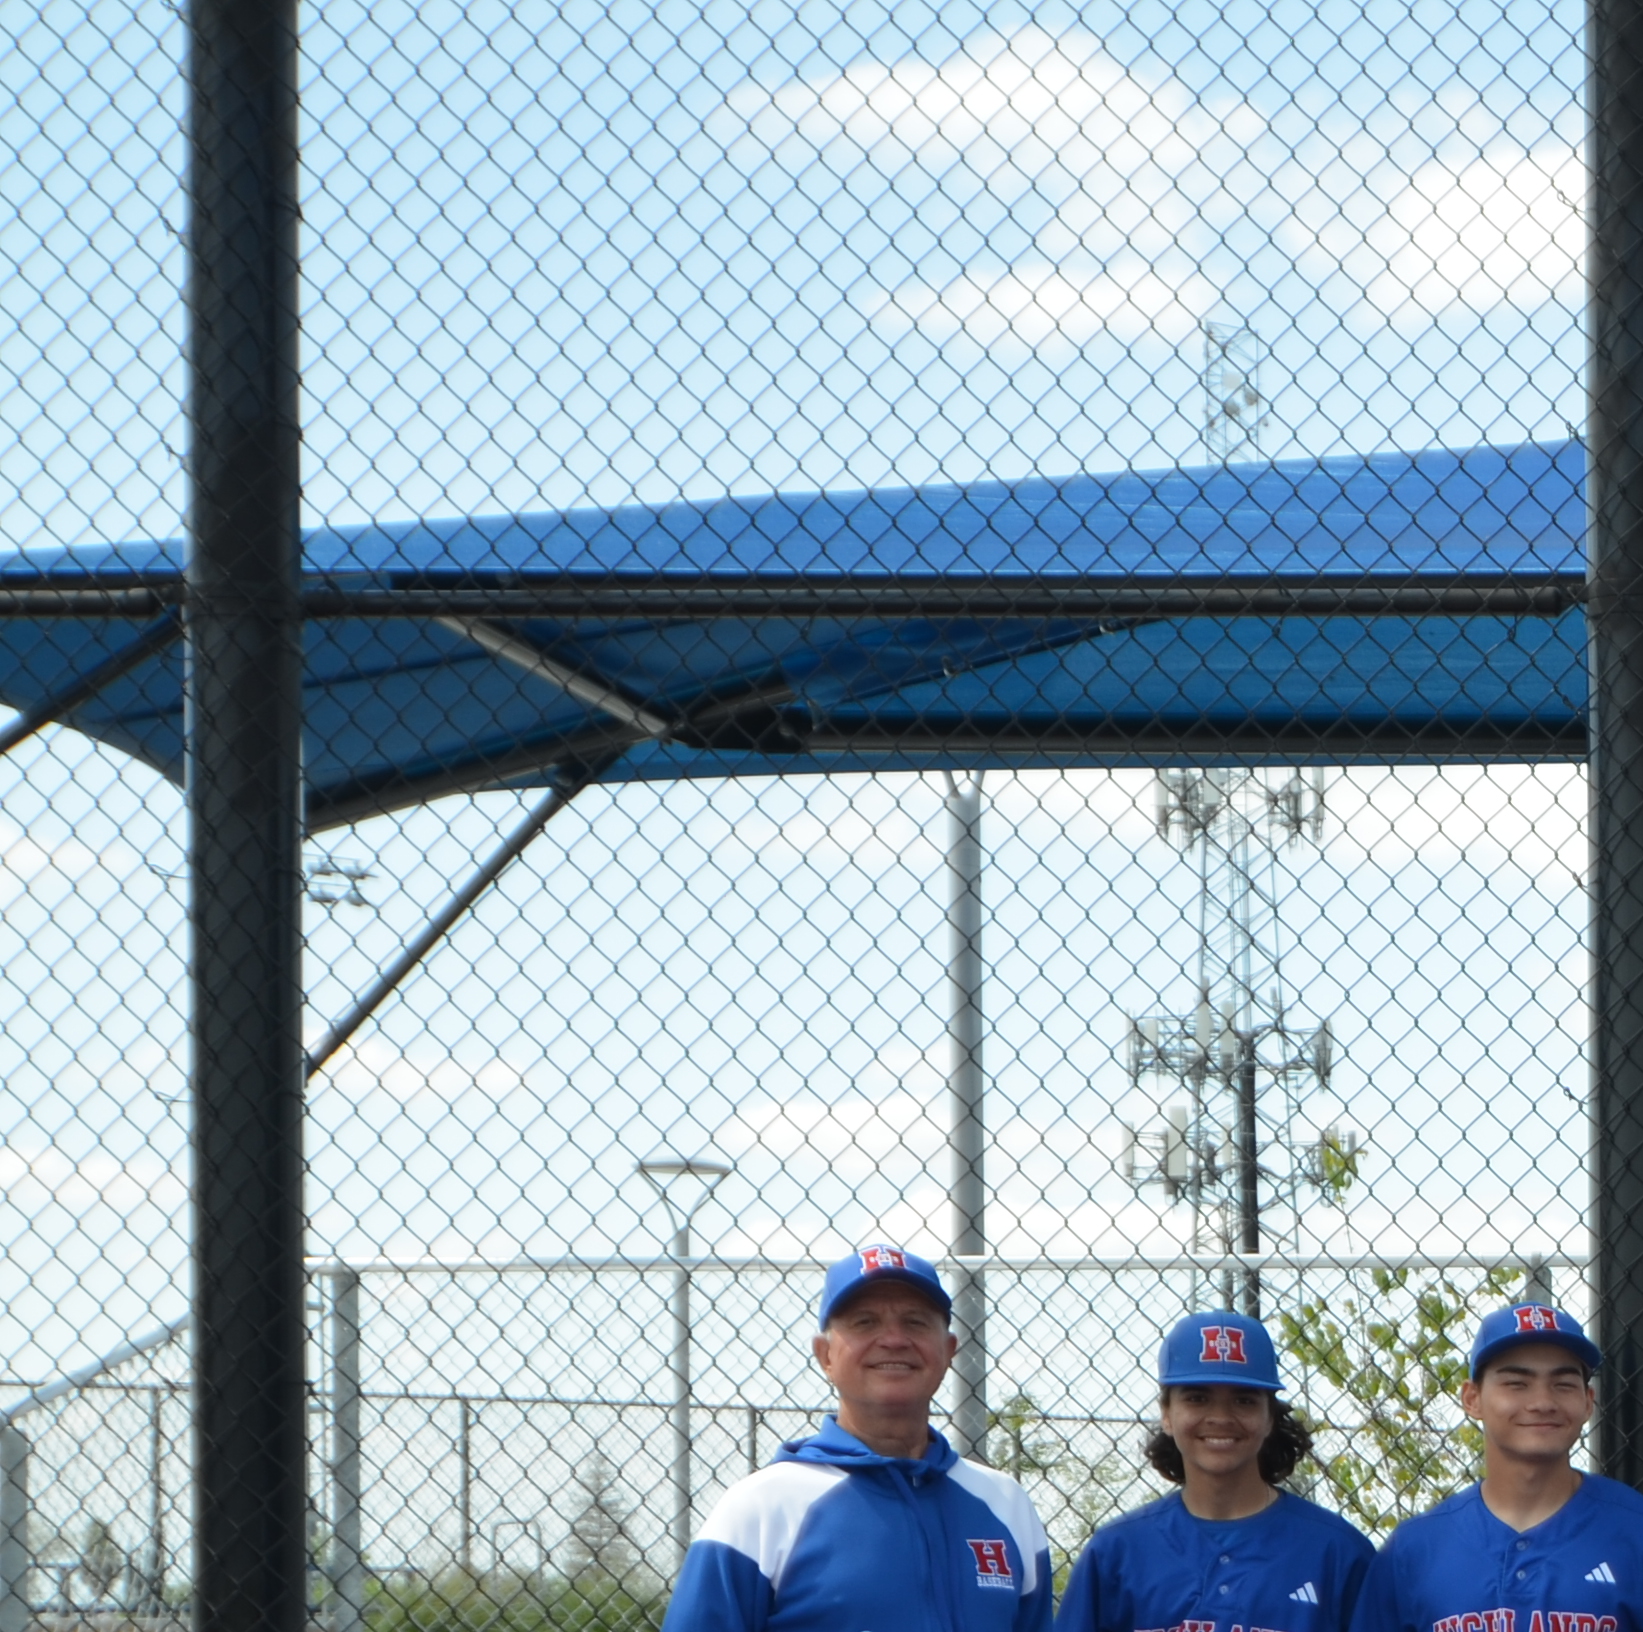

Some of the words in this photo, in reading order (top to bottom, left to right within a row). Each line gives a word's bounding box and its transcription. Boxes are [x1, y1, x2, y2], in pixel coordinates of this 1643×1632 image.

[858, 1245, 906, 1274] H
[1515, 1305, 1560, 1333] H
[1200, 1325, 1248, 1364] H
[966, 1539, 1012, 1577] H
